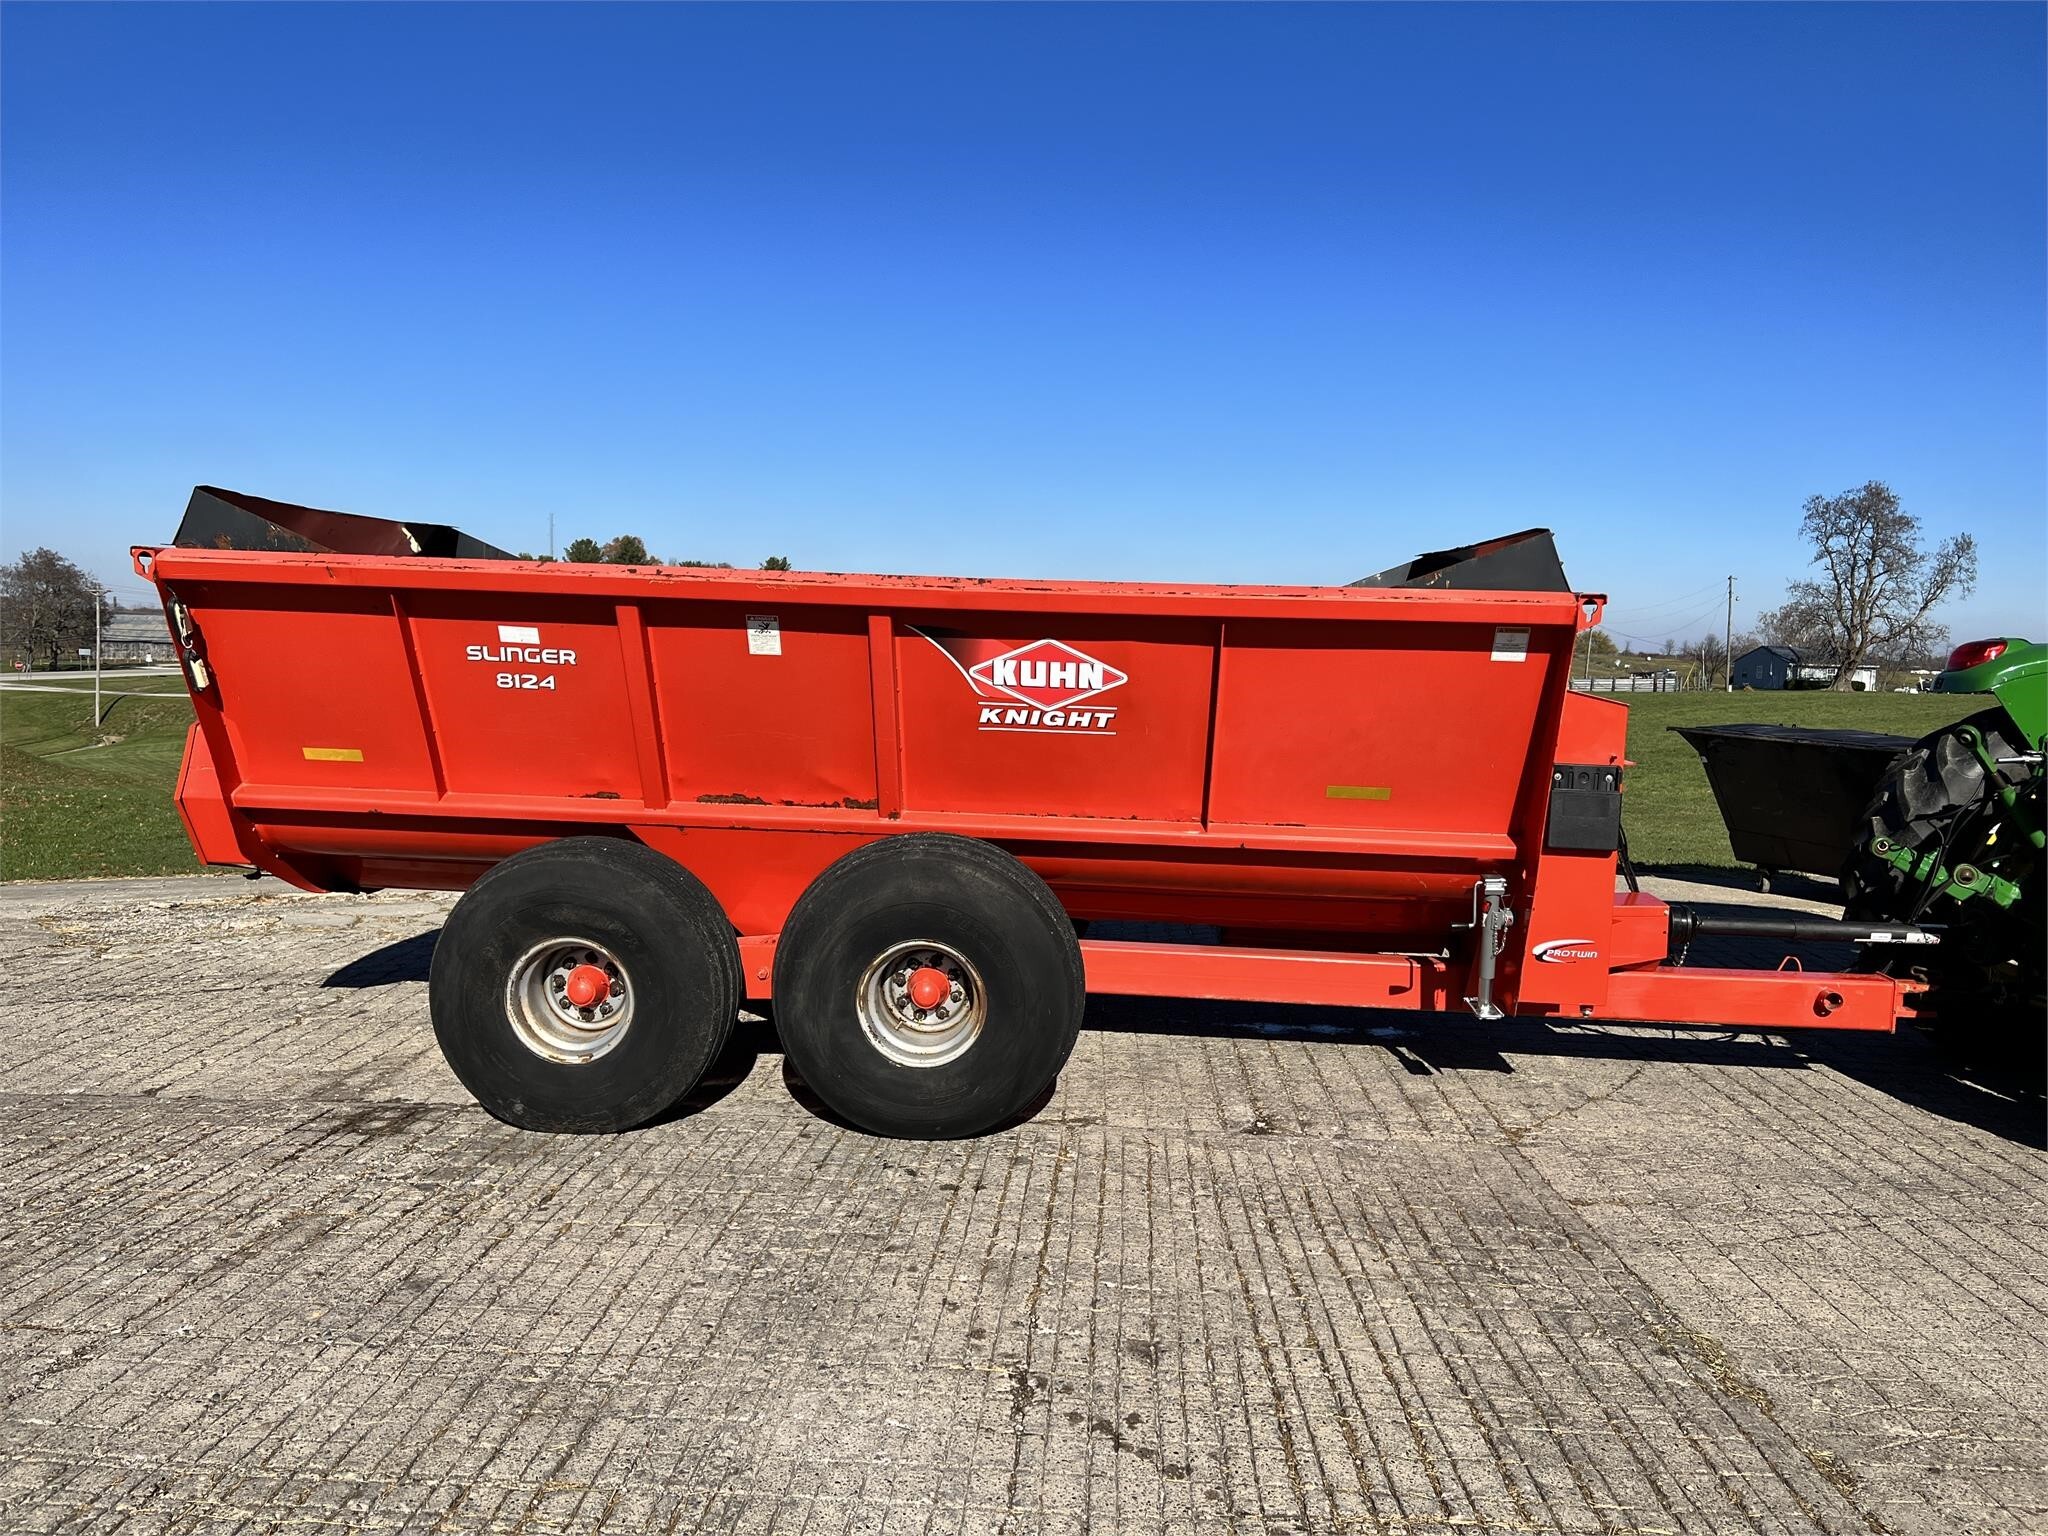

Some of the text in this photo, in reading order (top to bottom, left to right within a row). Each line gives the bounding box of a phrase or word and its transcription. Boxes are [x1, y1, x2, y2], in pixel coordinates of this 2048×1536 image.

[466, 646, 577, 665] SLINGER
[496, 673, 555, 690] 8124
[992, 660, 1103, 690] KUHN
[979, 708, 1115, 728] KNIGHT
[1546, 949, 1598, 958] PROTWIN
